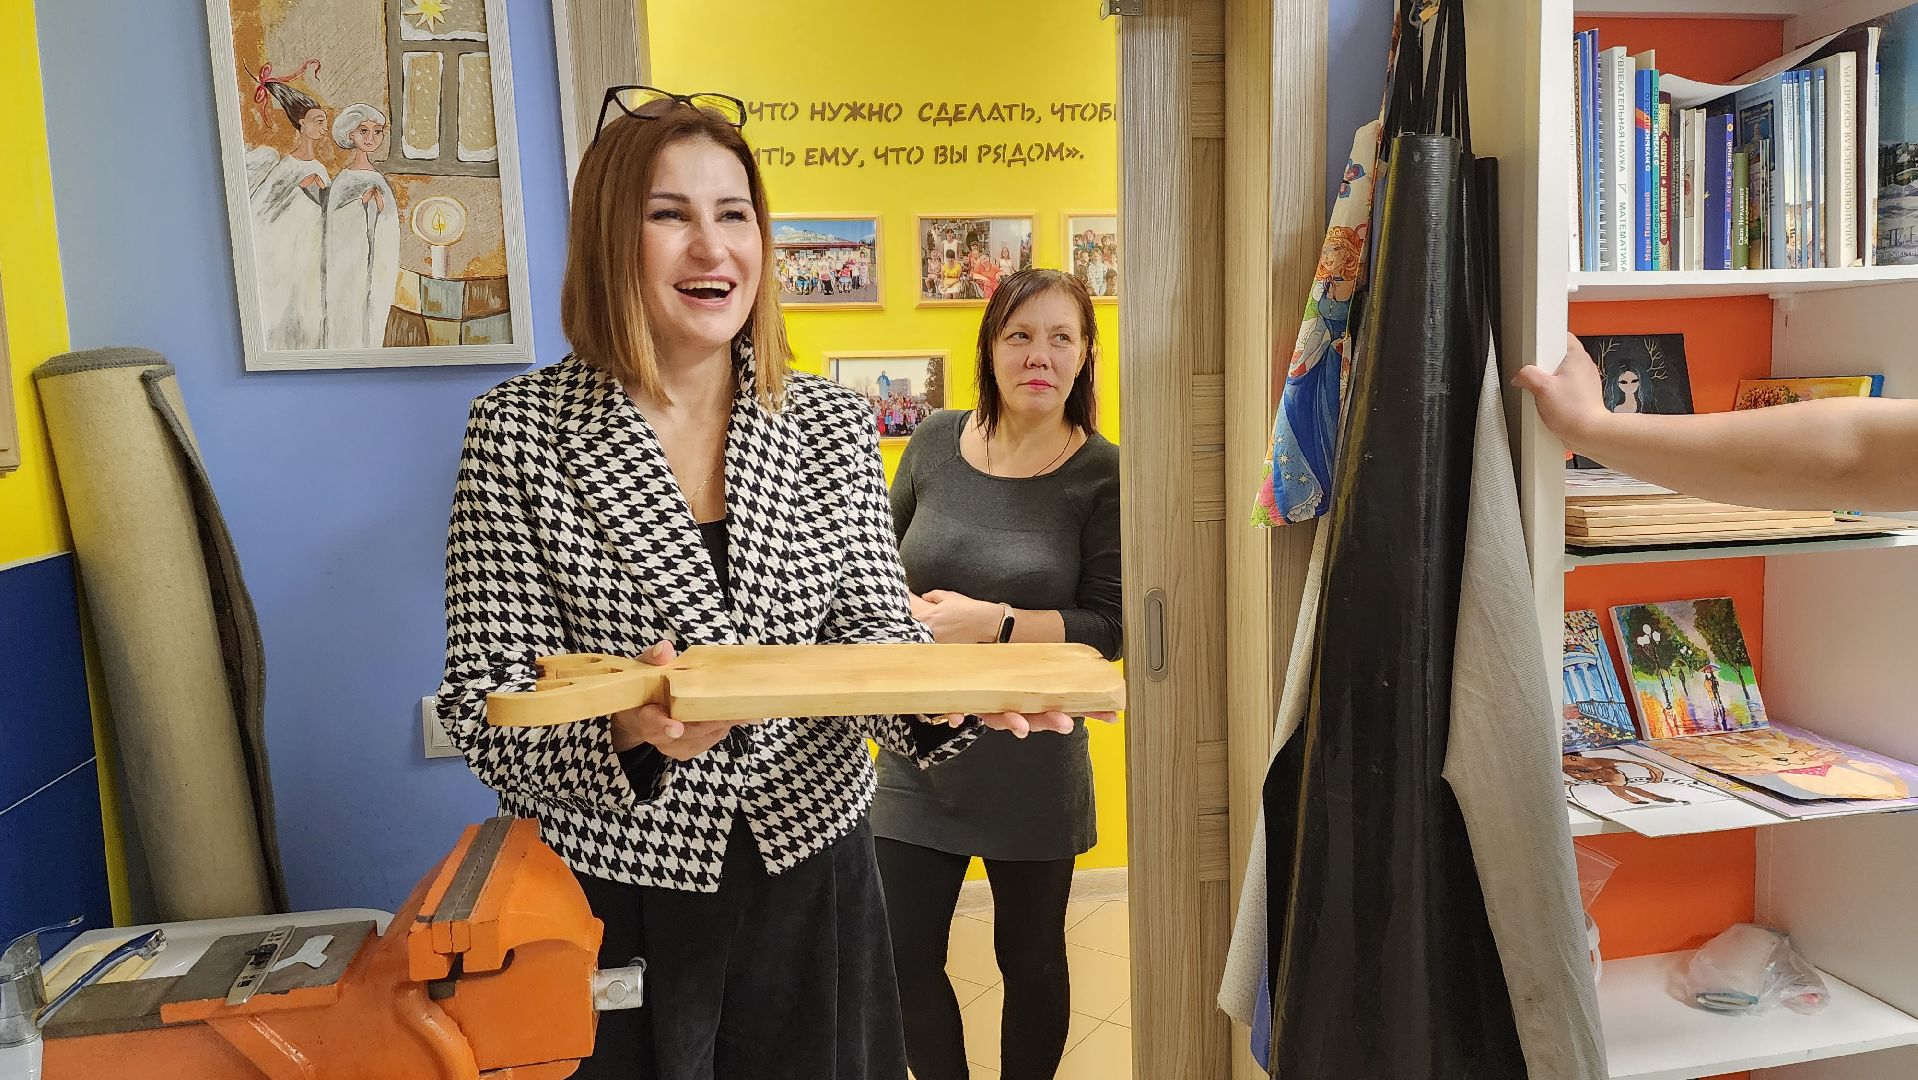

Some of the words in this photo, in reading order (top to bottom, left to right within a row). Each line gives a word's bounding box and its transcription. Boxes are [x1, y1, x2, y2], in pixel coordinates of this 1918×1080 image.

[749, 101, 799, 122] ЧТО
[810, 101, 903, 123] НУЖНО
[918, 101, 1042, 127] СДЕЛАТЬ,
[1050, 102, 1117, 123] ЧТОБ
[1617, 55, 1625, 138] УВЛЕКАТЕЛЬНАЯ
[1843, 65, 1852, 128] СКУЛЬПТУРА
[804, 146, 865, 168] ЕМУ,
[873, 145, 925, 165] ЧТО
[933, 144, 968, 165] ВЫ
[977, 141, 1085, 168] РЯДОМ».
[1660, 186, 1668, 211] ЗАВЕТ
[1842, 132, 1852, 249] ЗАПАДНОЕВРОПЕЙСКАЯ
[1619, 202, 1628, 272] МАТЕМАТИКА
